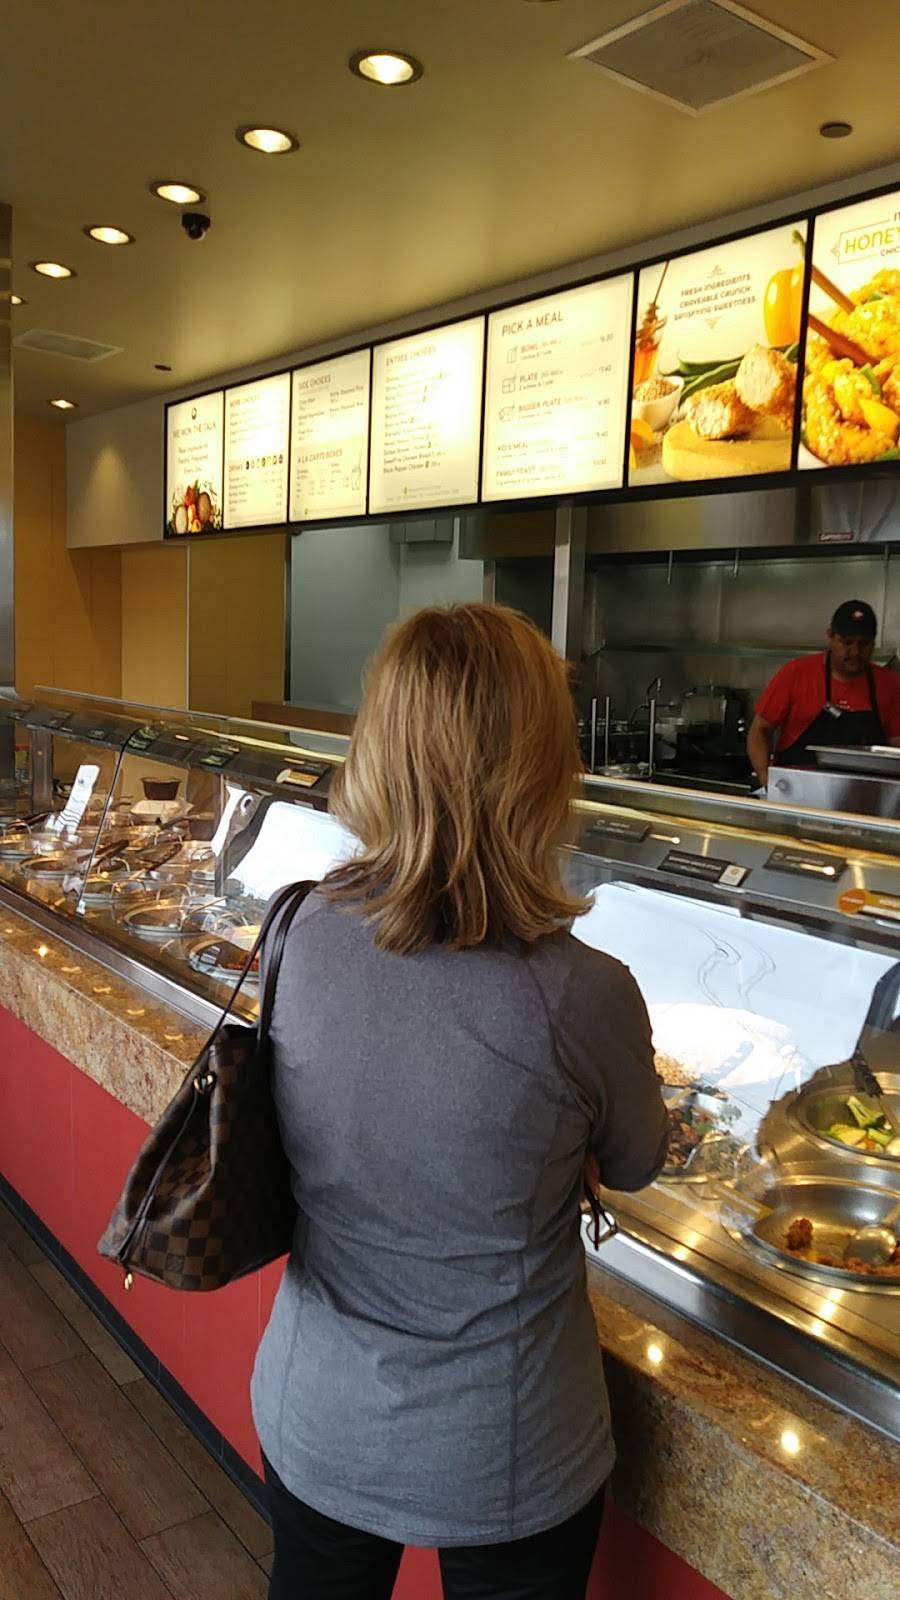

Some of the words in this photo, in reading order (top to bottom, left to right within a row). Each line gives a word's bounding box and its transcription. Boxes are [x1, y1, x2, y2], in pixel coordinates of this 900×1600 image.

[681, 287, 703, 297] FRESH
[502, 320, 524, 337] PICK
[526, 319, 533, 330] A
[536, 310, 564, 328] MEAL
[520, 371, 538, 383] PLATE
[542, 397, 561, 408] PLATE
